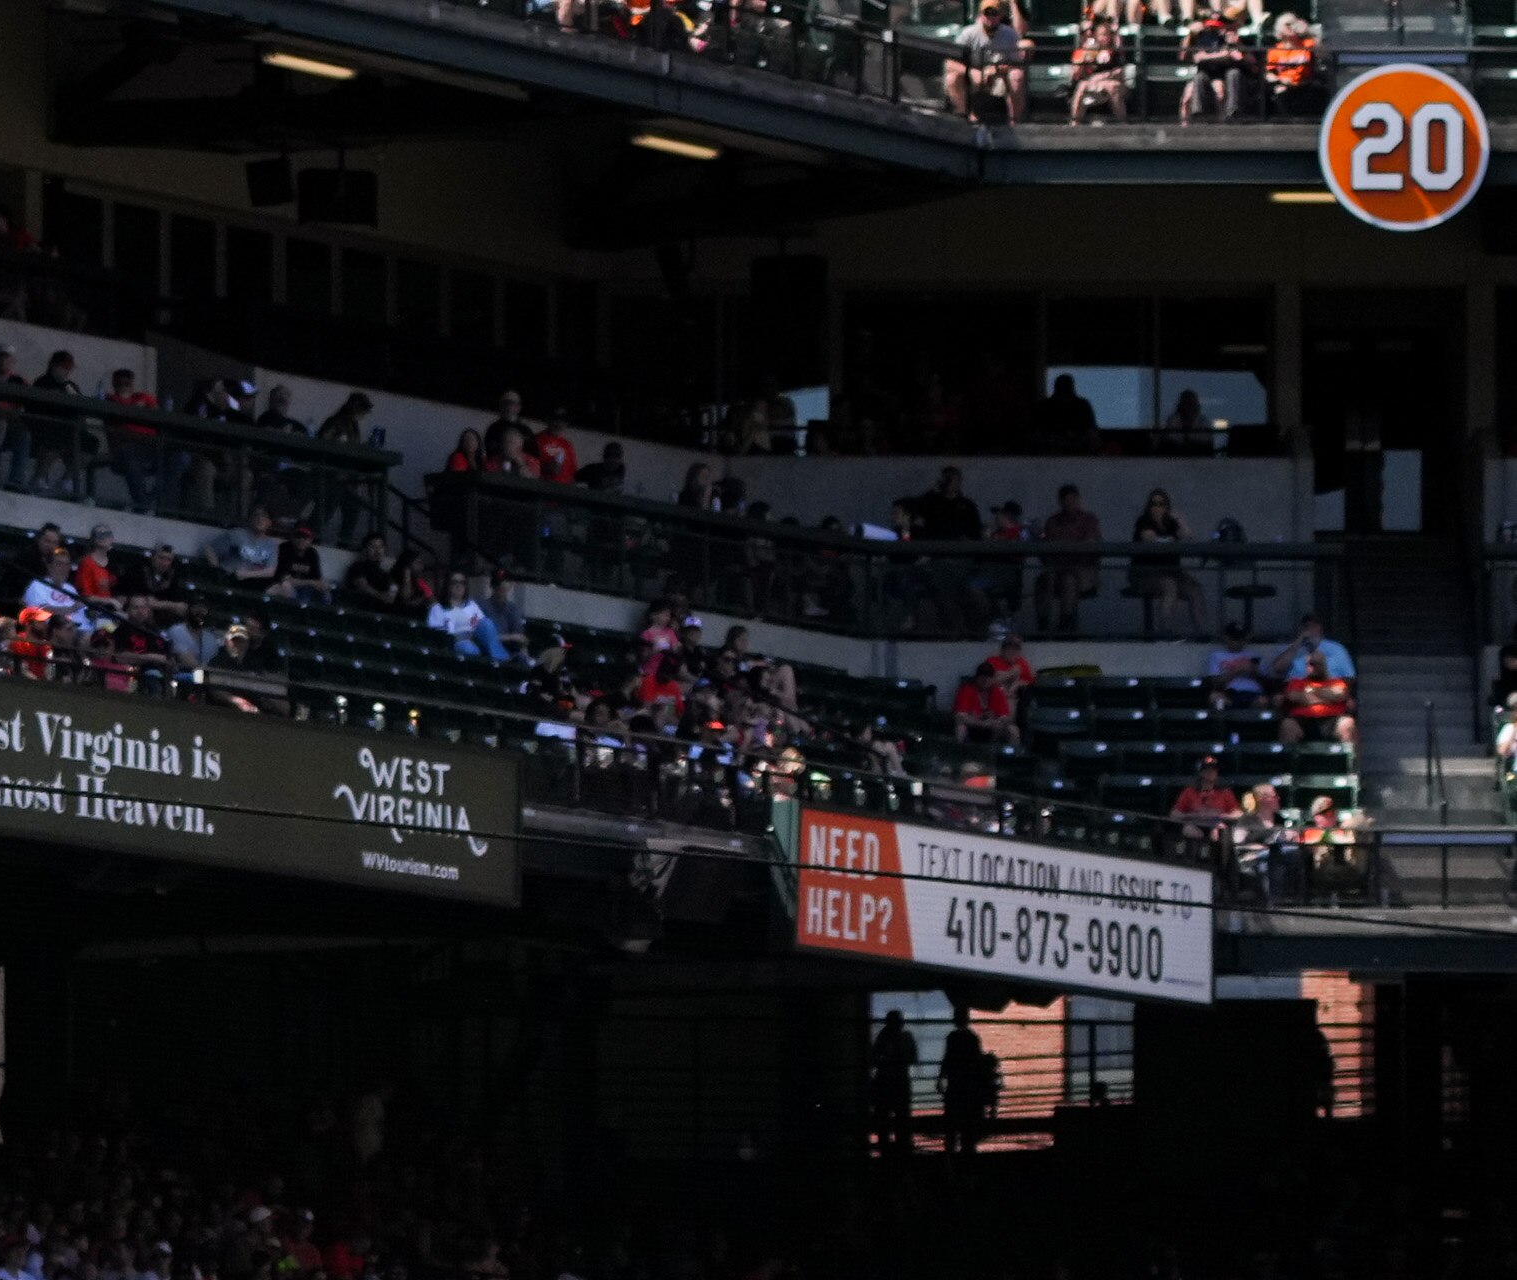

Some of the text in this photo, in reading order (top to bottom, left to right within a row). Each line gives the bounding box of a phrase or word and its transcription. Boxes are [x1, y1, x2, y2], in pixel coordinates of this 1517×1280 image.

[1351, 102, 1464, 191] 20
[35, 711, 182, 776] Virginia
[191, 735, 222, 781] is
[358, 747, 451, 796] WEST
[75, 772, 215, 836] Heaven.
[333, 784, 489, 857] VIRGINIA
[808, 823, 881, 882] NEED
[918, 842, 1193, 921] TEXT LOCATION AND ISSUE TO
[806, 886, 892, 944] HELP?
[946, 897, 1164, 984] 410-873-9900
